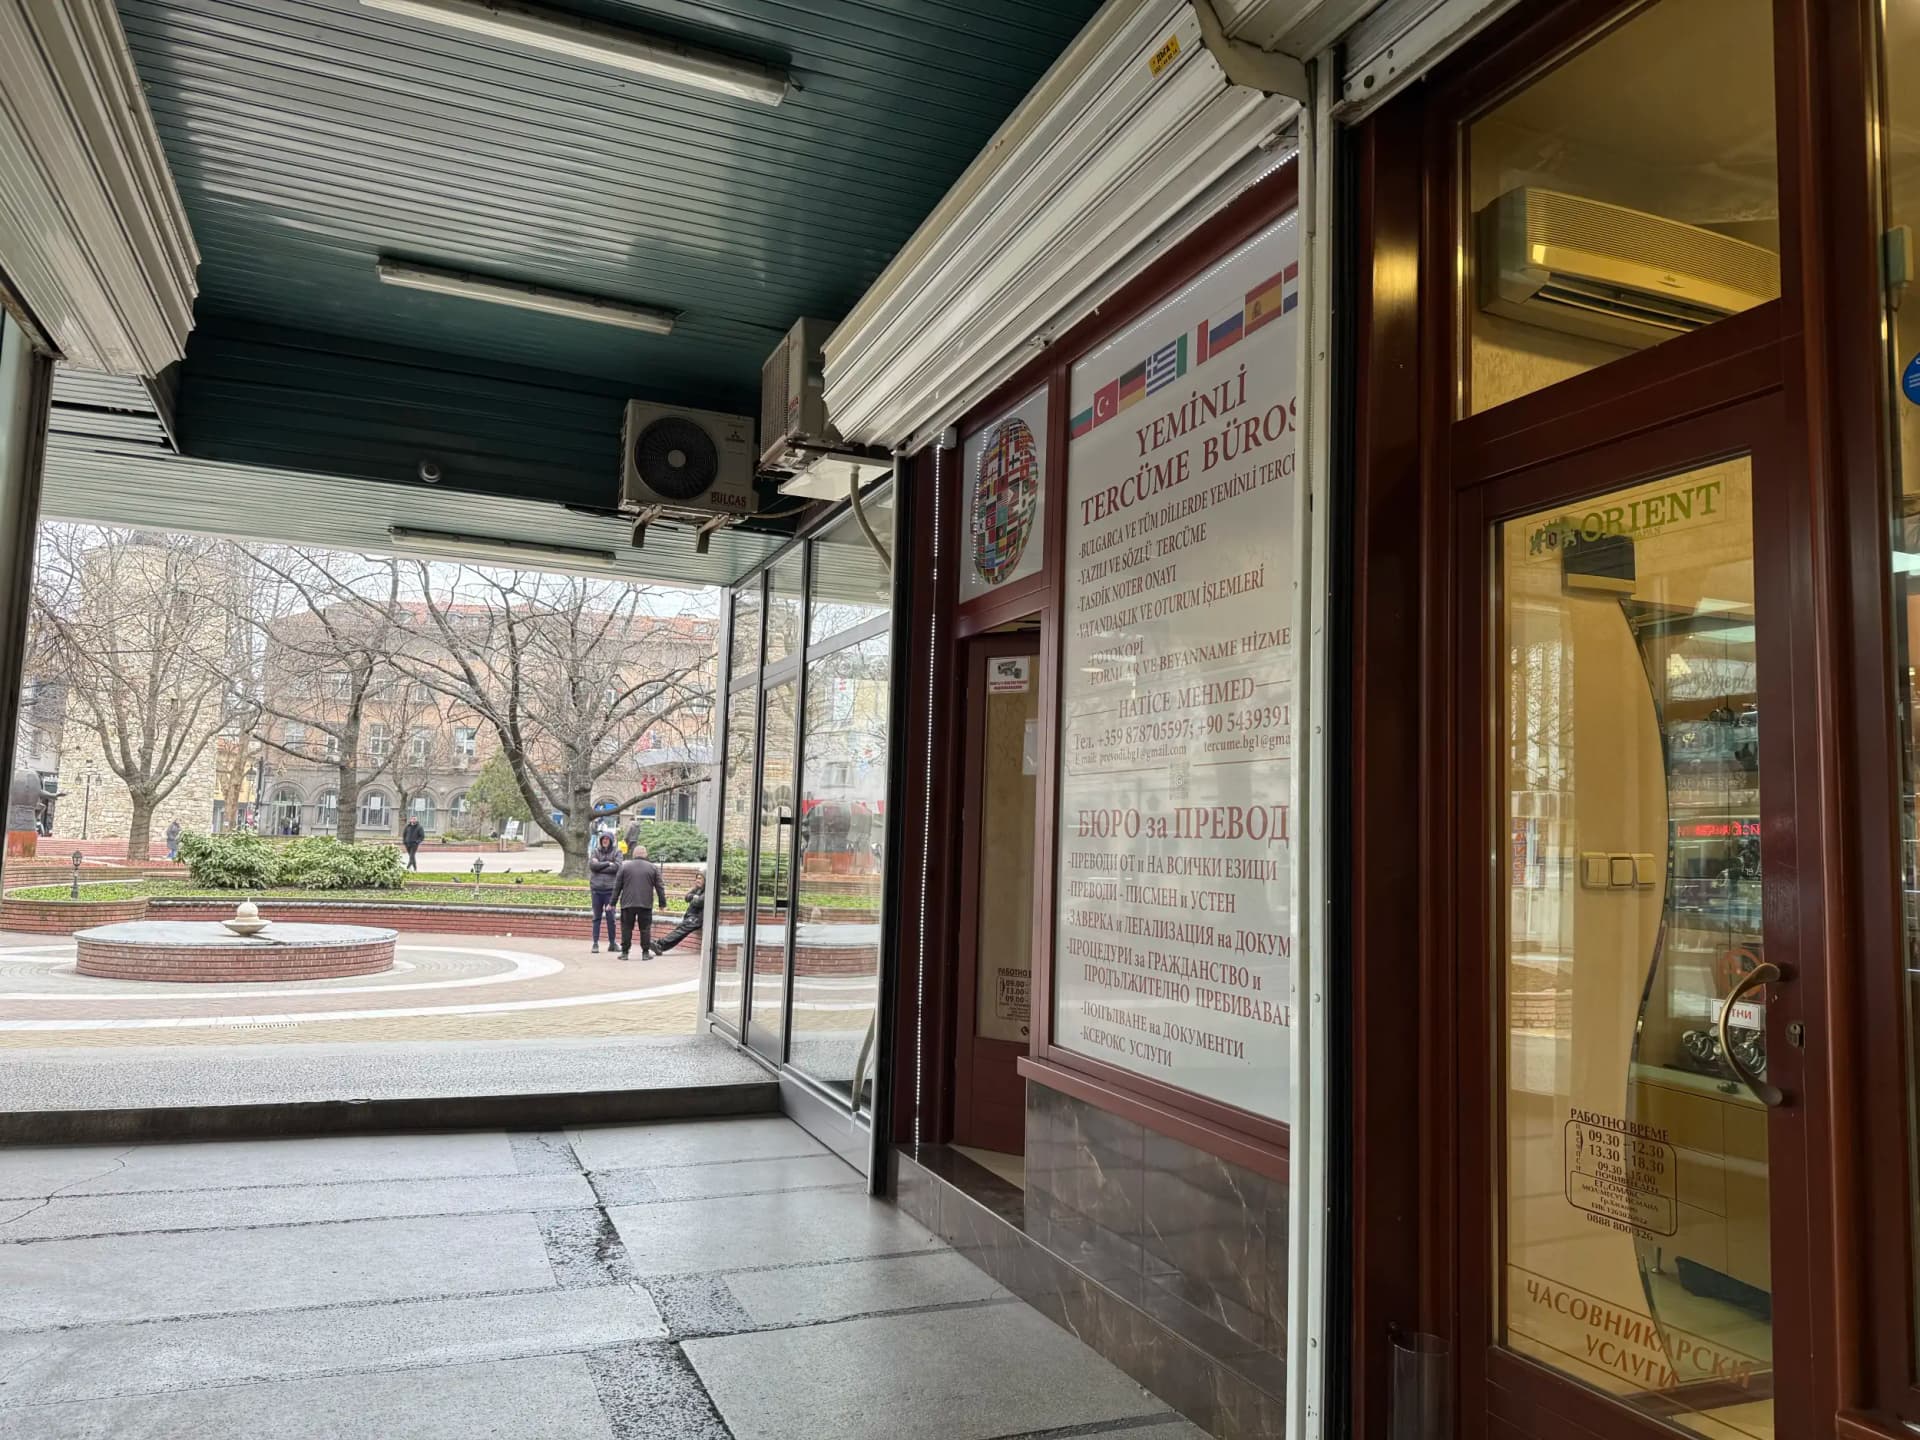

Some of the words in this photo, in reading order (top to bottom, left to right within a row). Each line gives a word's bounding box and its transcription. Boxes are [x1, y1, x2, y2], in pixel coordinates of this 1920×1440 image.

[1136, 363, 1248, 457] YEMİNLİ
[1081, 450, 1190, 526] TERCÜME
[1125, 521, 1136, 540] VE
[1138, 511, 1158, 535] TÜM
[1160, 490, 1208, 526] DİLLERDE
[1210, 465, 1256, 506] YEMİNLİ
[1581, 481, 1720, 542] ORIENT
[1109, 556, 1120, 573] VE
[1157, 522, 1207, 557] TERCÜME
[1113, 576, 1143, 600] NOTER
[1145, 564, 1177, 590] ONAYI
[1140, 602, 1152, 621] VE
[1154, 588, 1200, 618] OTURUM
[1202, 563, 1265, 608] İŞLEMLERİ
[1160, 640, 1238, 672] BEYANNAME
[1119, 687, 1170, 718] HATİCE
[1178, 677, 1255, 709] MEHMED
[1078, 808, 1141, 839] БЮРО
[1146, 816, 1168, 839] за
[1120, 855, 1136, 872] ОТ
[1147, 855, 1164, 874] НА
[1167, 856, 1222, 878] ВСИЧКИ
[1225, 859, 1278, 886] ЕЗИЦИ
[1126, 884, 1177, 908] ПИСМЕН
[1190, 891, 1236, 914] УСТЕН
[1124, 916, 1214, 947] ЛЕГАЛИЗАЦИЯ
[1217, 934, 1232, 949] на
[1084, 964, 1190, 1004] ПРОДЪЛЖИТЕЛНО
[1134, 955, 1145, 968] за
[1148, 951, 1249, 988] ГРАЖДАНСТВО
[1253, 975, 1261, 991] и
[1129, 1039, 1172, 1068] УСЛУГИ
[1149, 1020, 1161, 1036] на
[1163, 1022, 1244, 1060] ДОКУМЕНТИ
[1570, 1108, 1626, 1131] РАБОТНО
[1630, 1122, 1668, 1141] ВРЕМЕ
[1588, 1129, 1620, 1147] 09.30
[1632, 1140, 1664, 1159] 12.30
[1589, 1144, 1620, 1162] 13.30
[1597, 1161, 1622, 1175] 09.30
[1587, 1213, 1611, 1228] 0888
[1613, 1220, 1632, 1234] 800
[1586, 1334, 1678, 1391] УСЛУГИ
